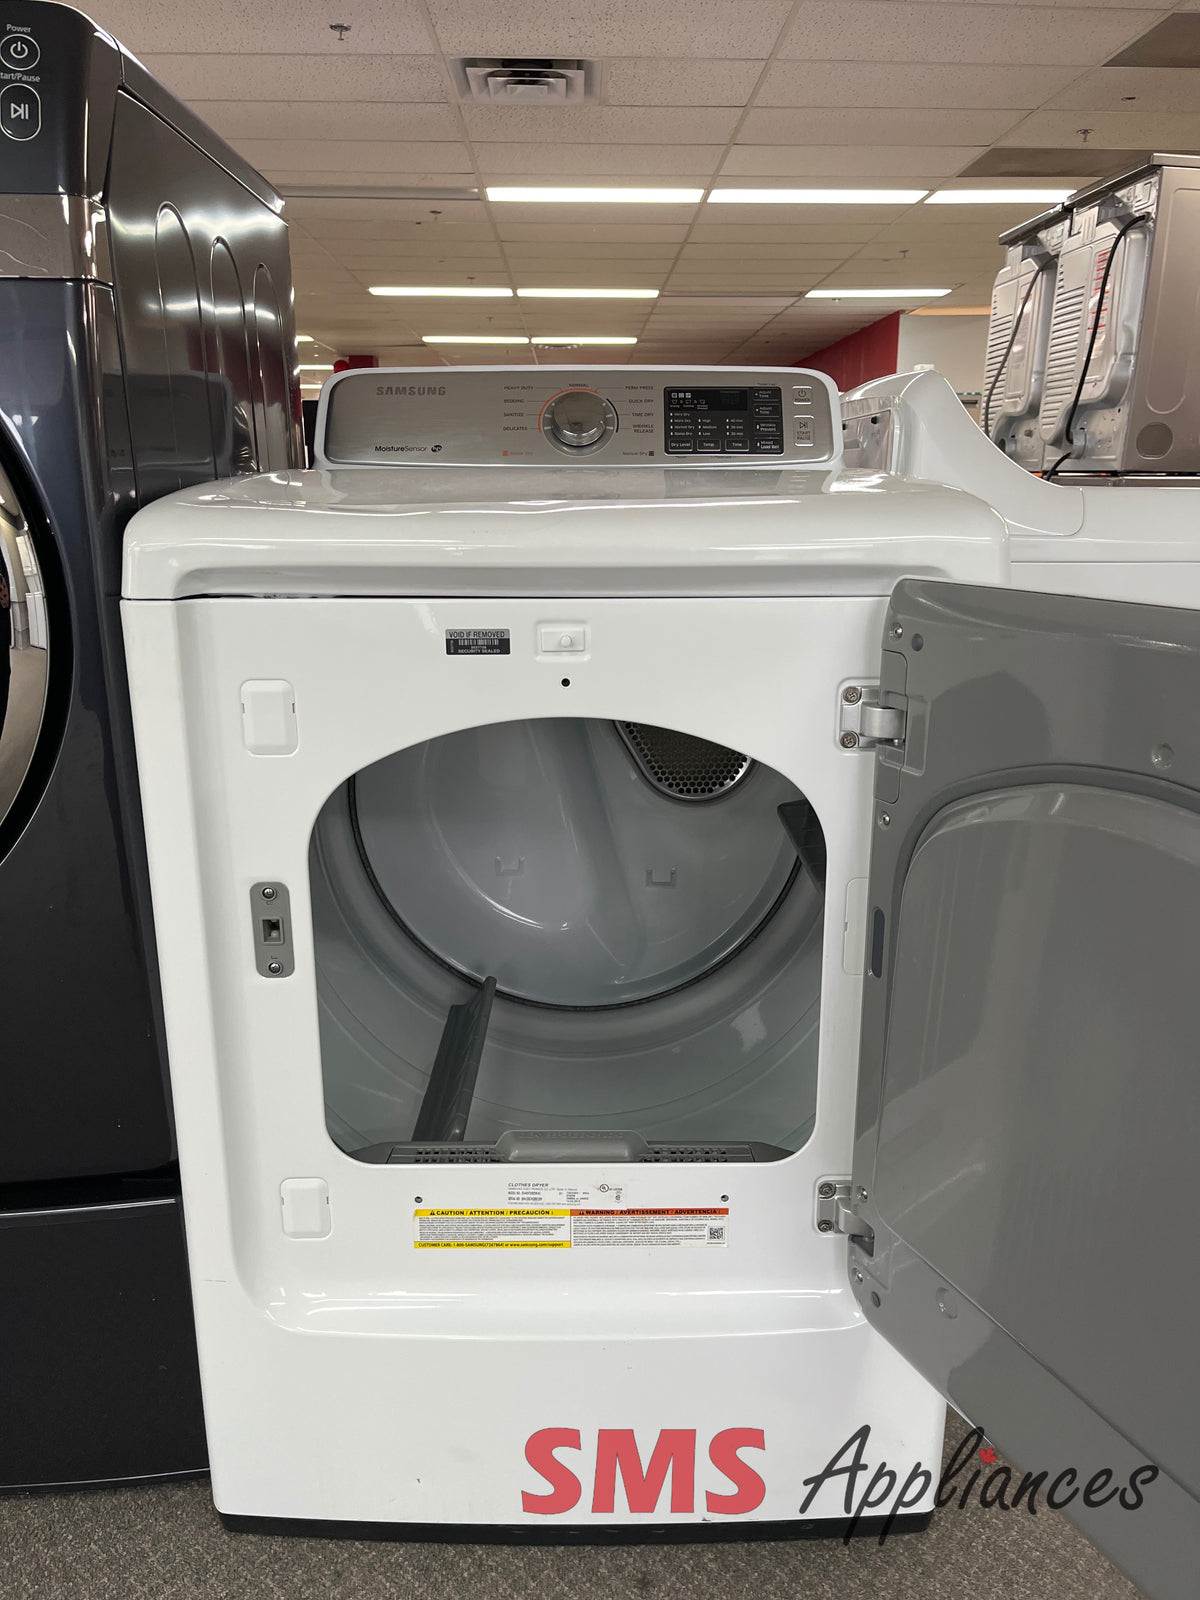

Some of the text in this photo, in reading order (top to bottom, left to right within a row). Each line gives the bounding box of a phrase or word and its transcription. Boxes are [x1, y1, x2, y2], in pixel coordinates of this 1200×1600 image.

[6, 23, 31, 33] Power
[0, 72, 40, 83] tart/Pause
[376, 386, 446, 396] SAMSUNG
